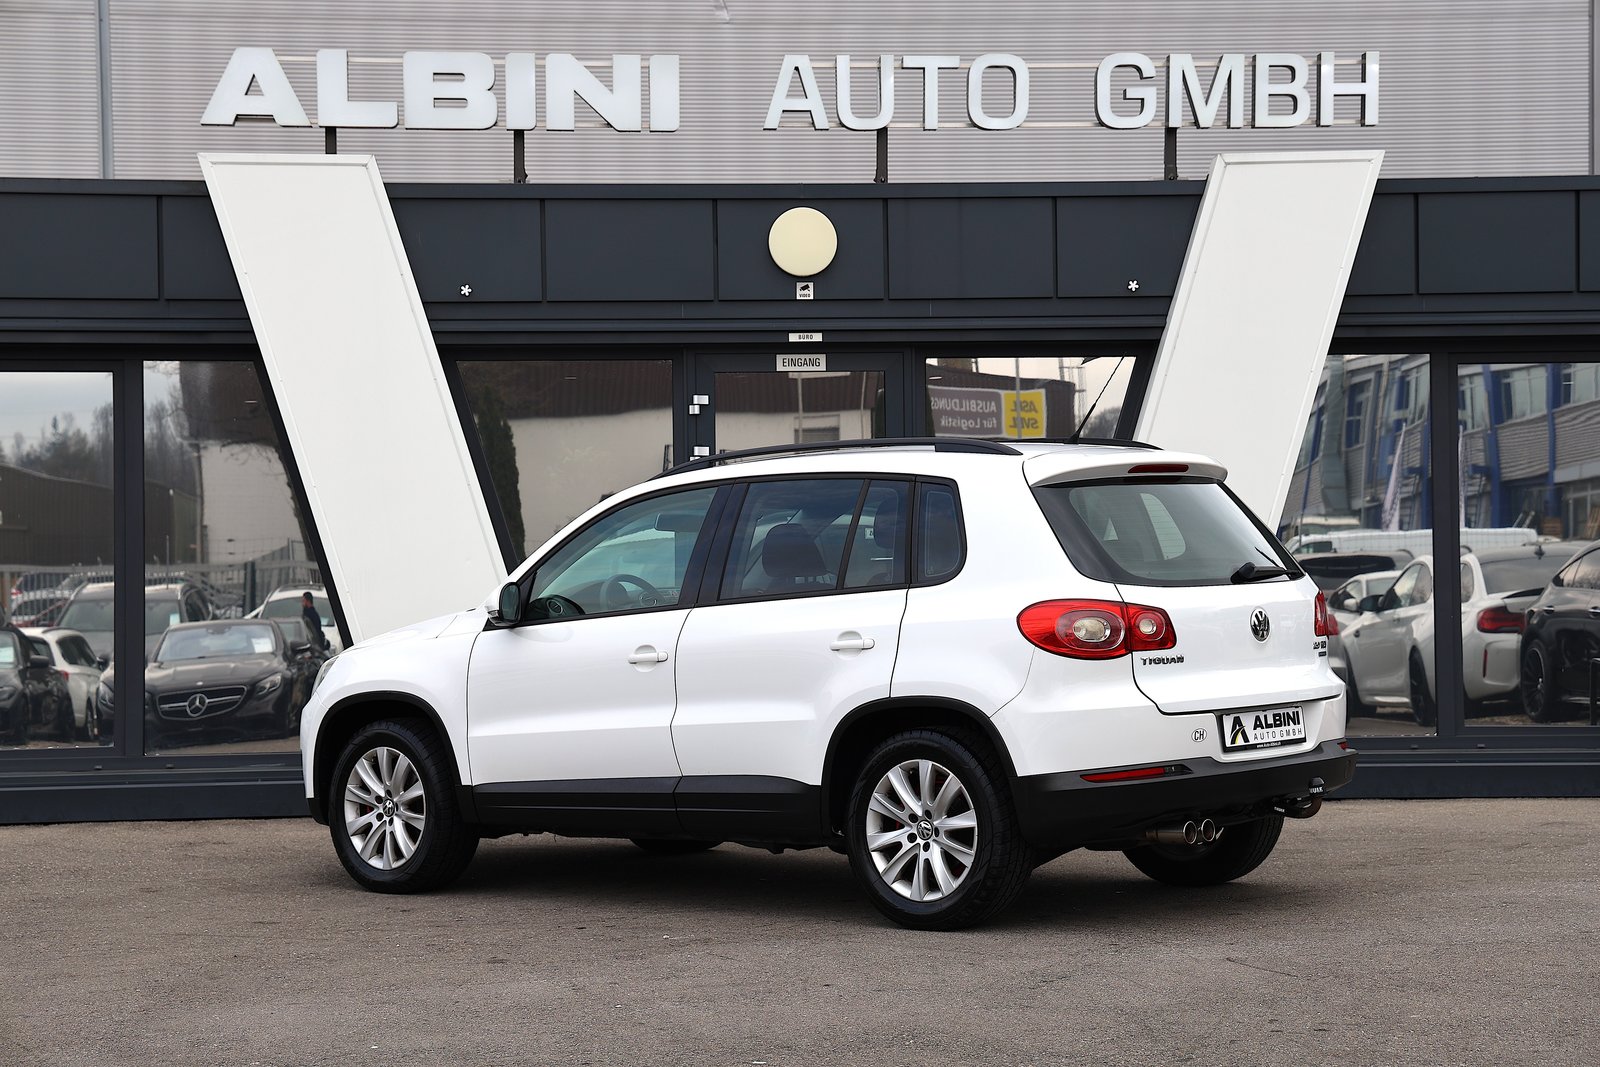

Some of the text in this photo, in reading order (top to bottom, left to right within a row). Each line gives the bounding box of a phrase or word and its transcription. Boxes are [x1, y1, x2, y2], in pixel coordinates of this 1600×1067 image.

[200, 47, 1380, 132] ALBINI AUTO GMBH
[782, 357, 821, 368] EINGANG
[1140, 655, 1184, 666] TIGUAN
[1253, 711, 1301, 730] ALBINI
[1194, 729, 1204, 741] CH
[1254, 728, 1302, 741] AUTO GMBH
